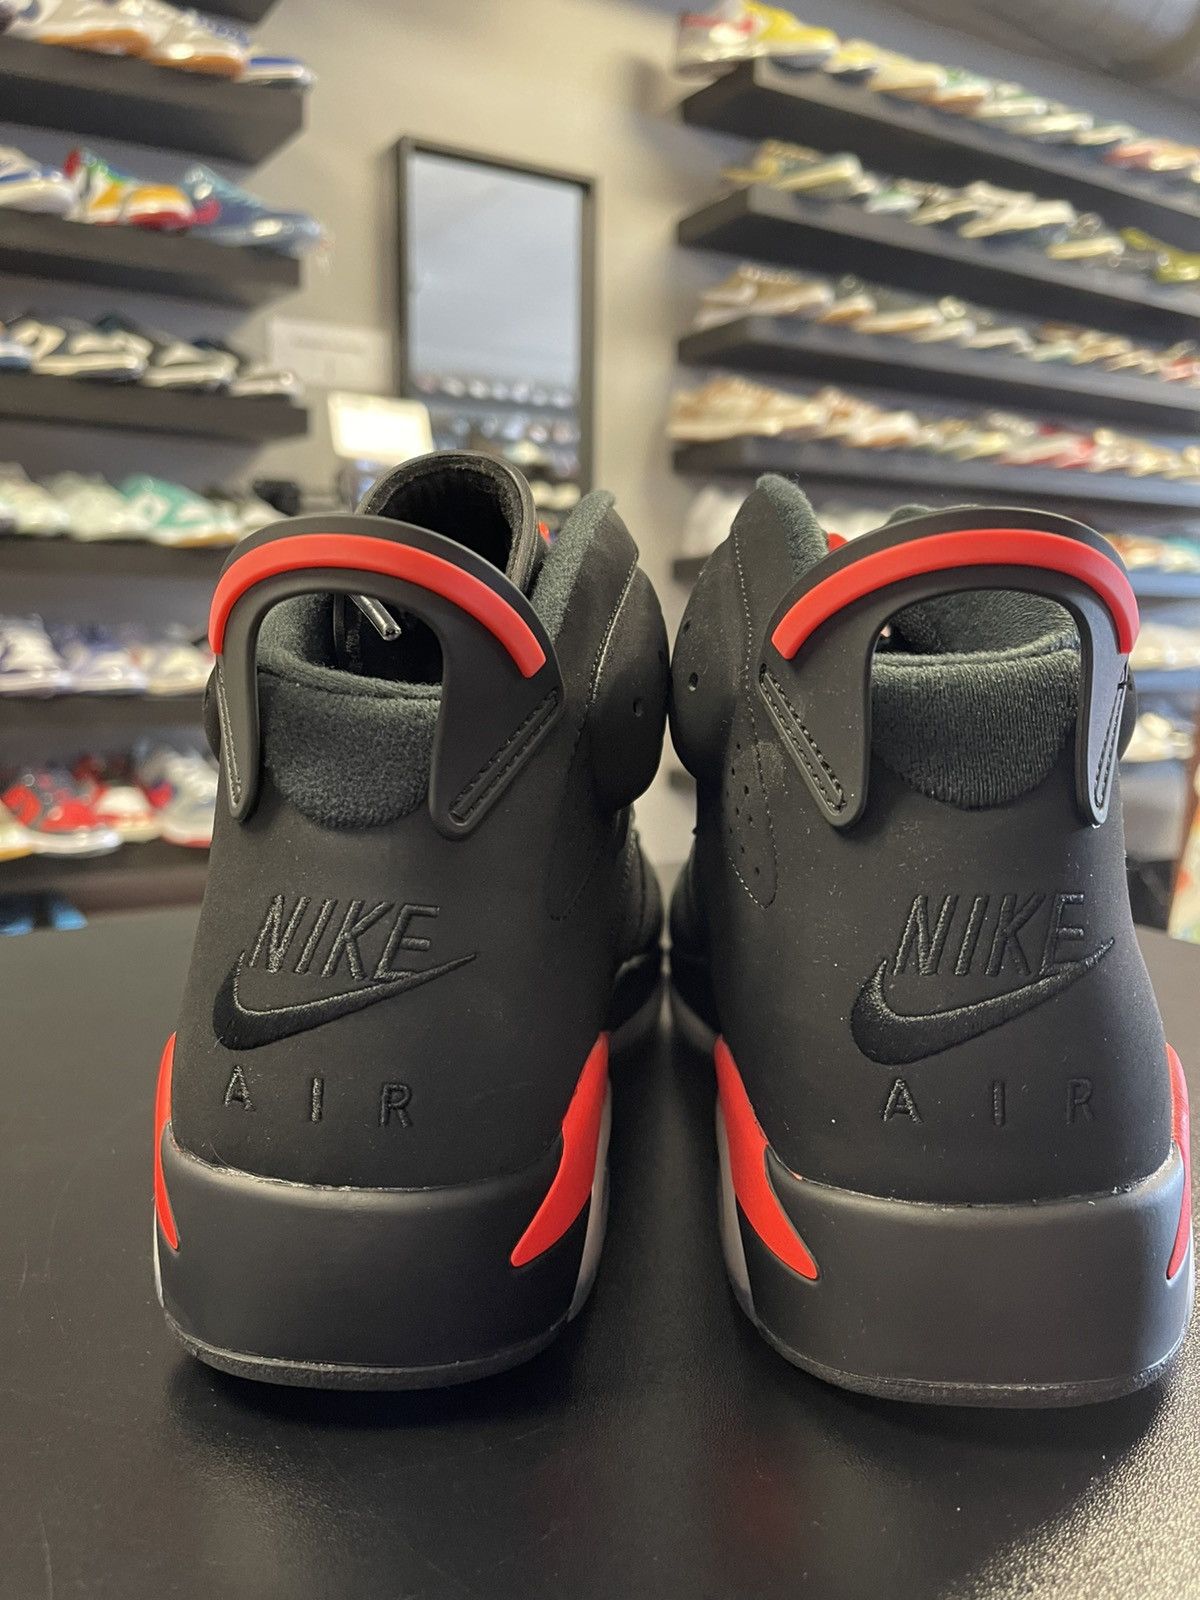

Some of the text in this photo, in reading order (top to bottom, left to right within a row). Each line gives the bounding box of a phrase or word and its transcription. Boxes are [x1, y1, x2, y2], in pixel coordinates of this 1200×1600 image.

[249, 894, 440, 981] NIKE
[893, 892, 1085, 977] NIKE
[223, 1064, 413, 1128] AIR
[880, 1077, 1095, 1126] AIR
